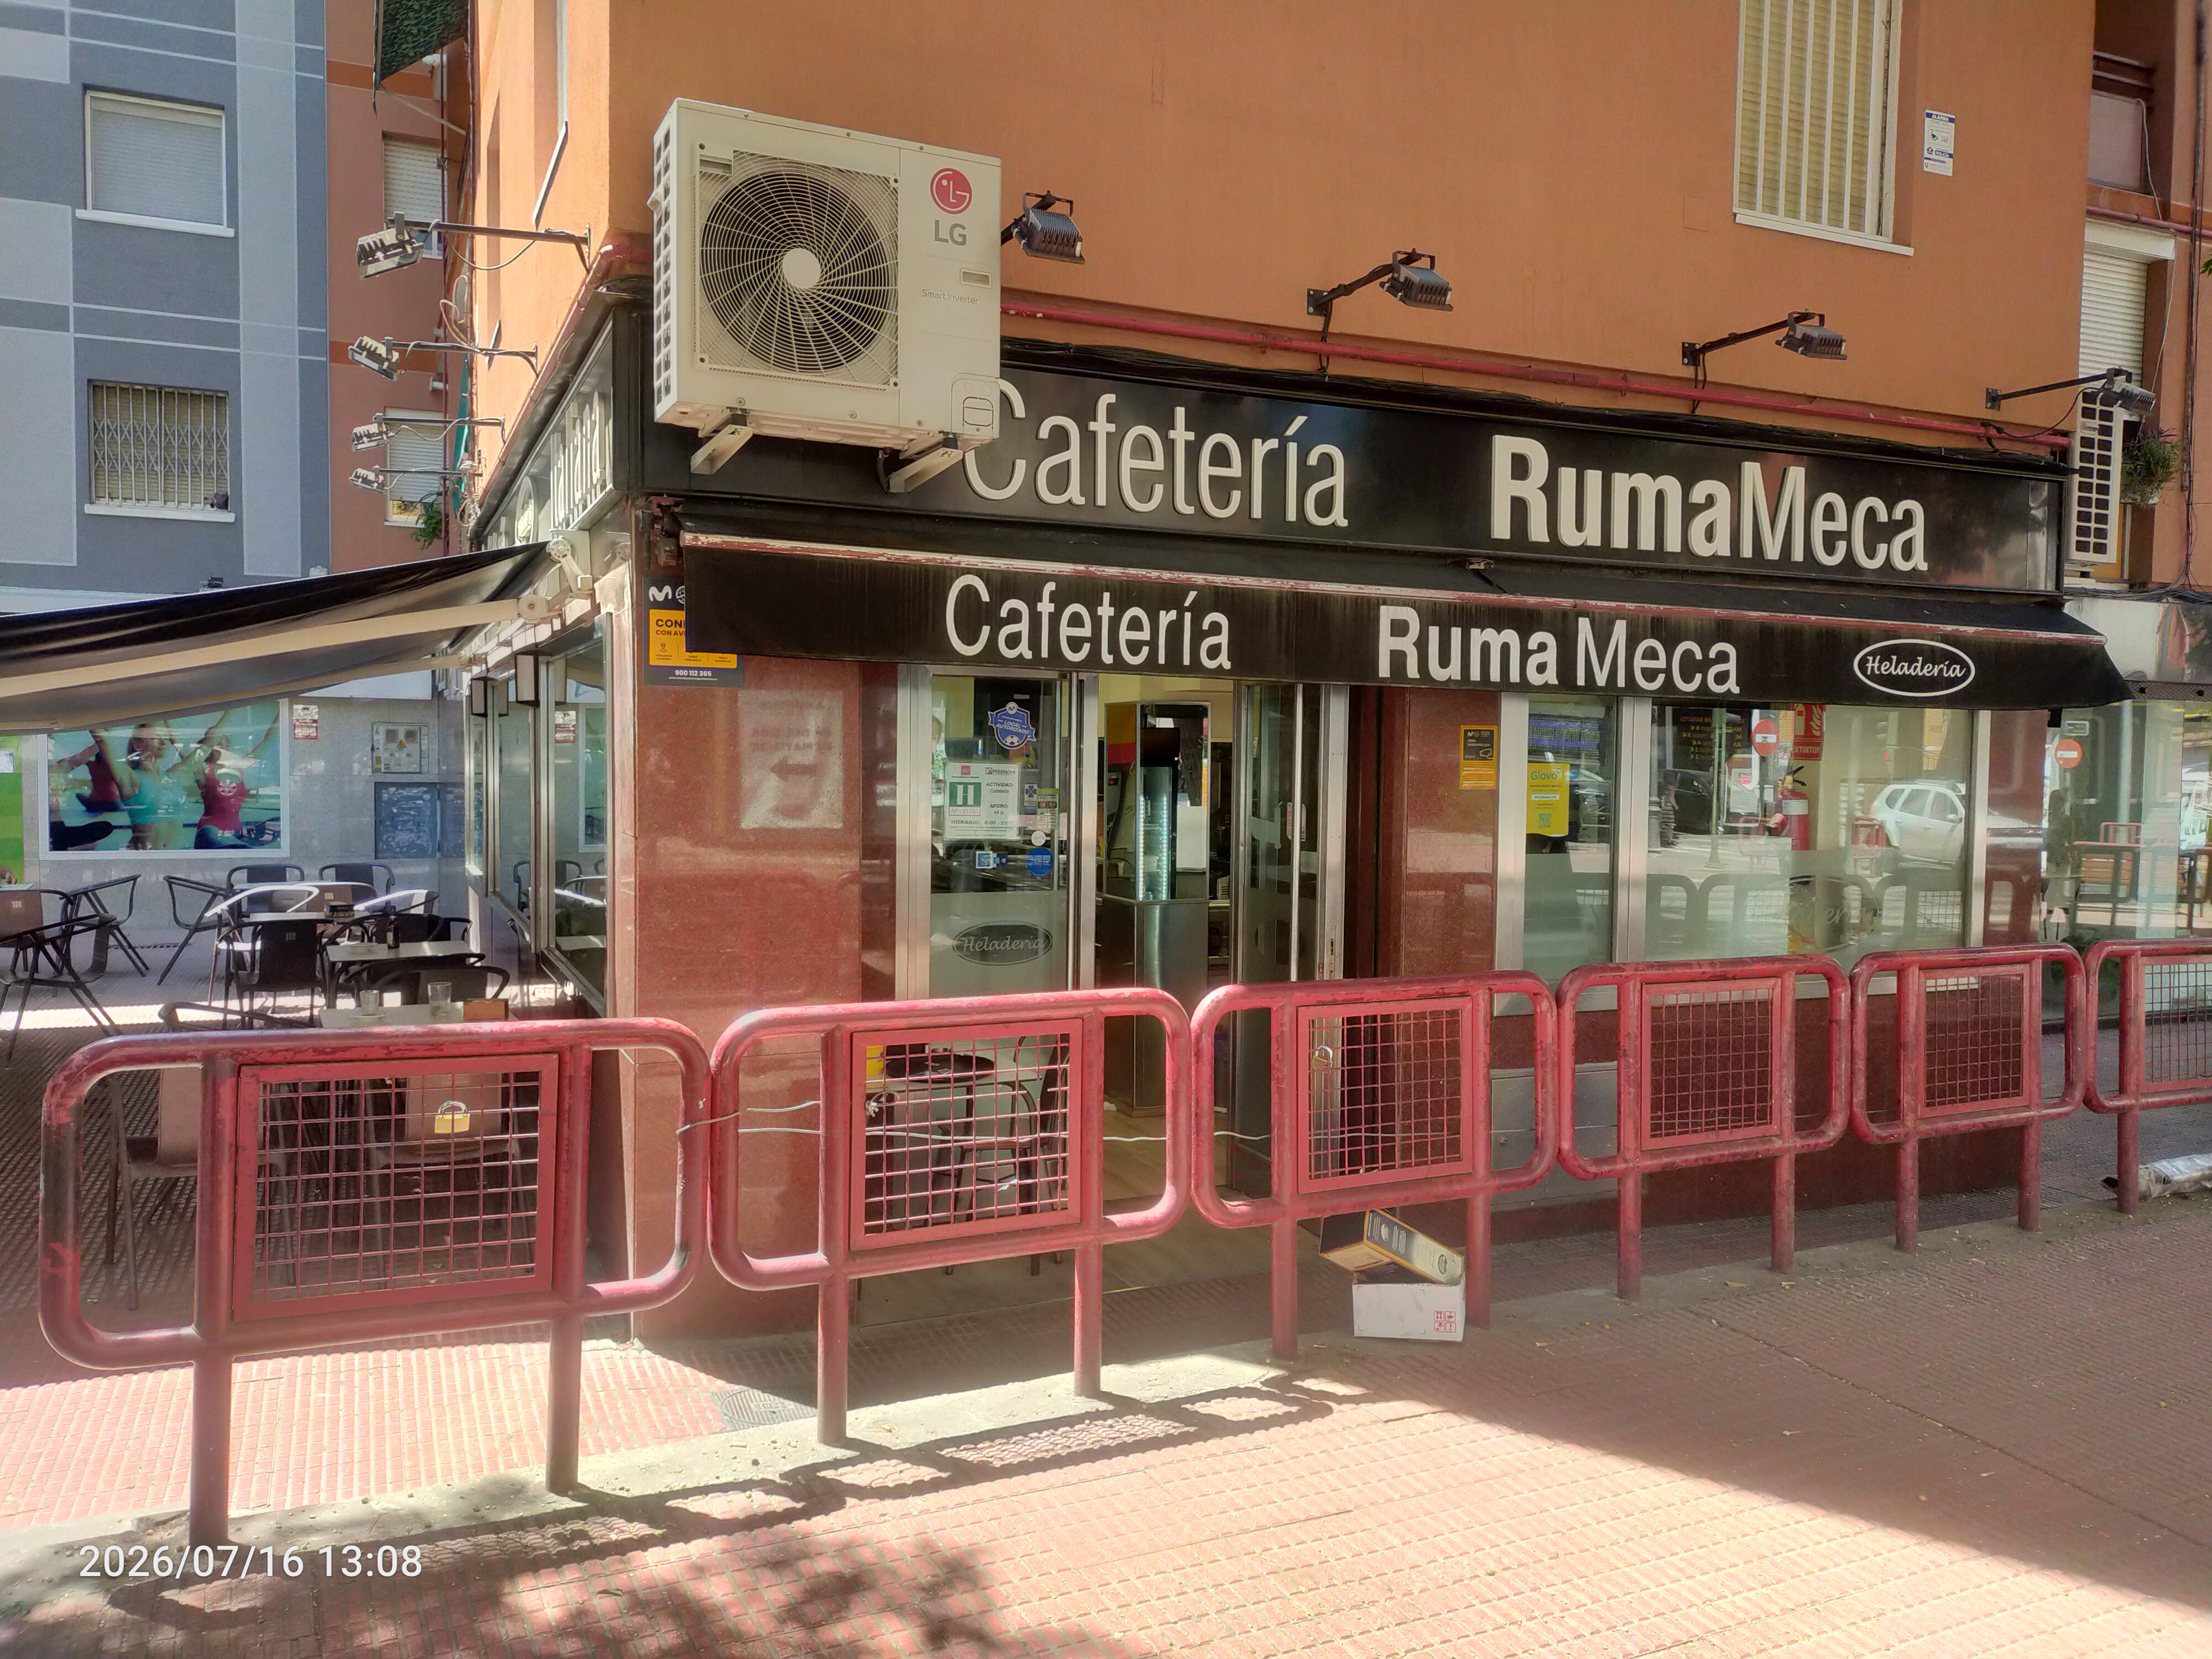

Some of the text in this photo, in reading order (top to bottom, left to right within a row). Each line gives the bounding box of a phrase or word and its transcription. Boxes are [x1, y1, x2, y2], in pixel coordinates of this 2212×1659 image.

[934, 220, 967, 246] LG
[922, 289, 978, 305] Smart Inverter
[964, 378, 1348, 527] Cafetería
[655, 618, 685, 628] CON
[946, 574, 1232, 670] Cafetería
[1378, 605, 1740, 694] Ruma Meca
[1865, 655, 1966, 677] Heladería
[995, 723, 1030, 734] AUTORIZADO
[1531, 770, 1557, 780] Glovo
[954, 784, 975, 805] H
[959, 935, 1048, 952] Heladería
